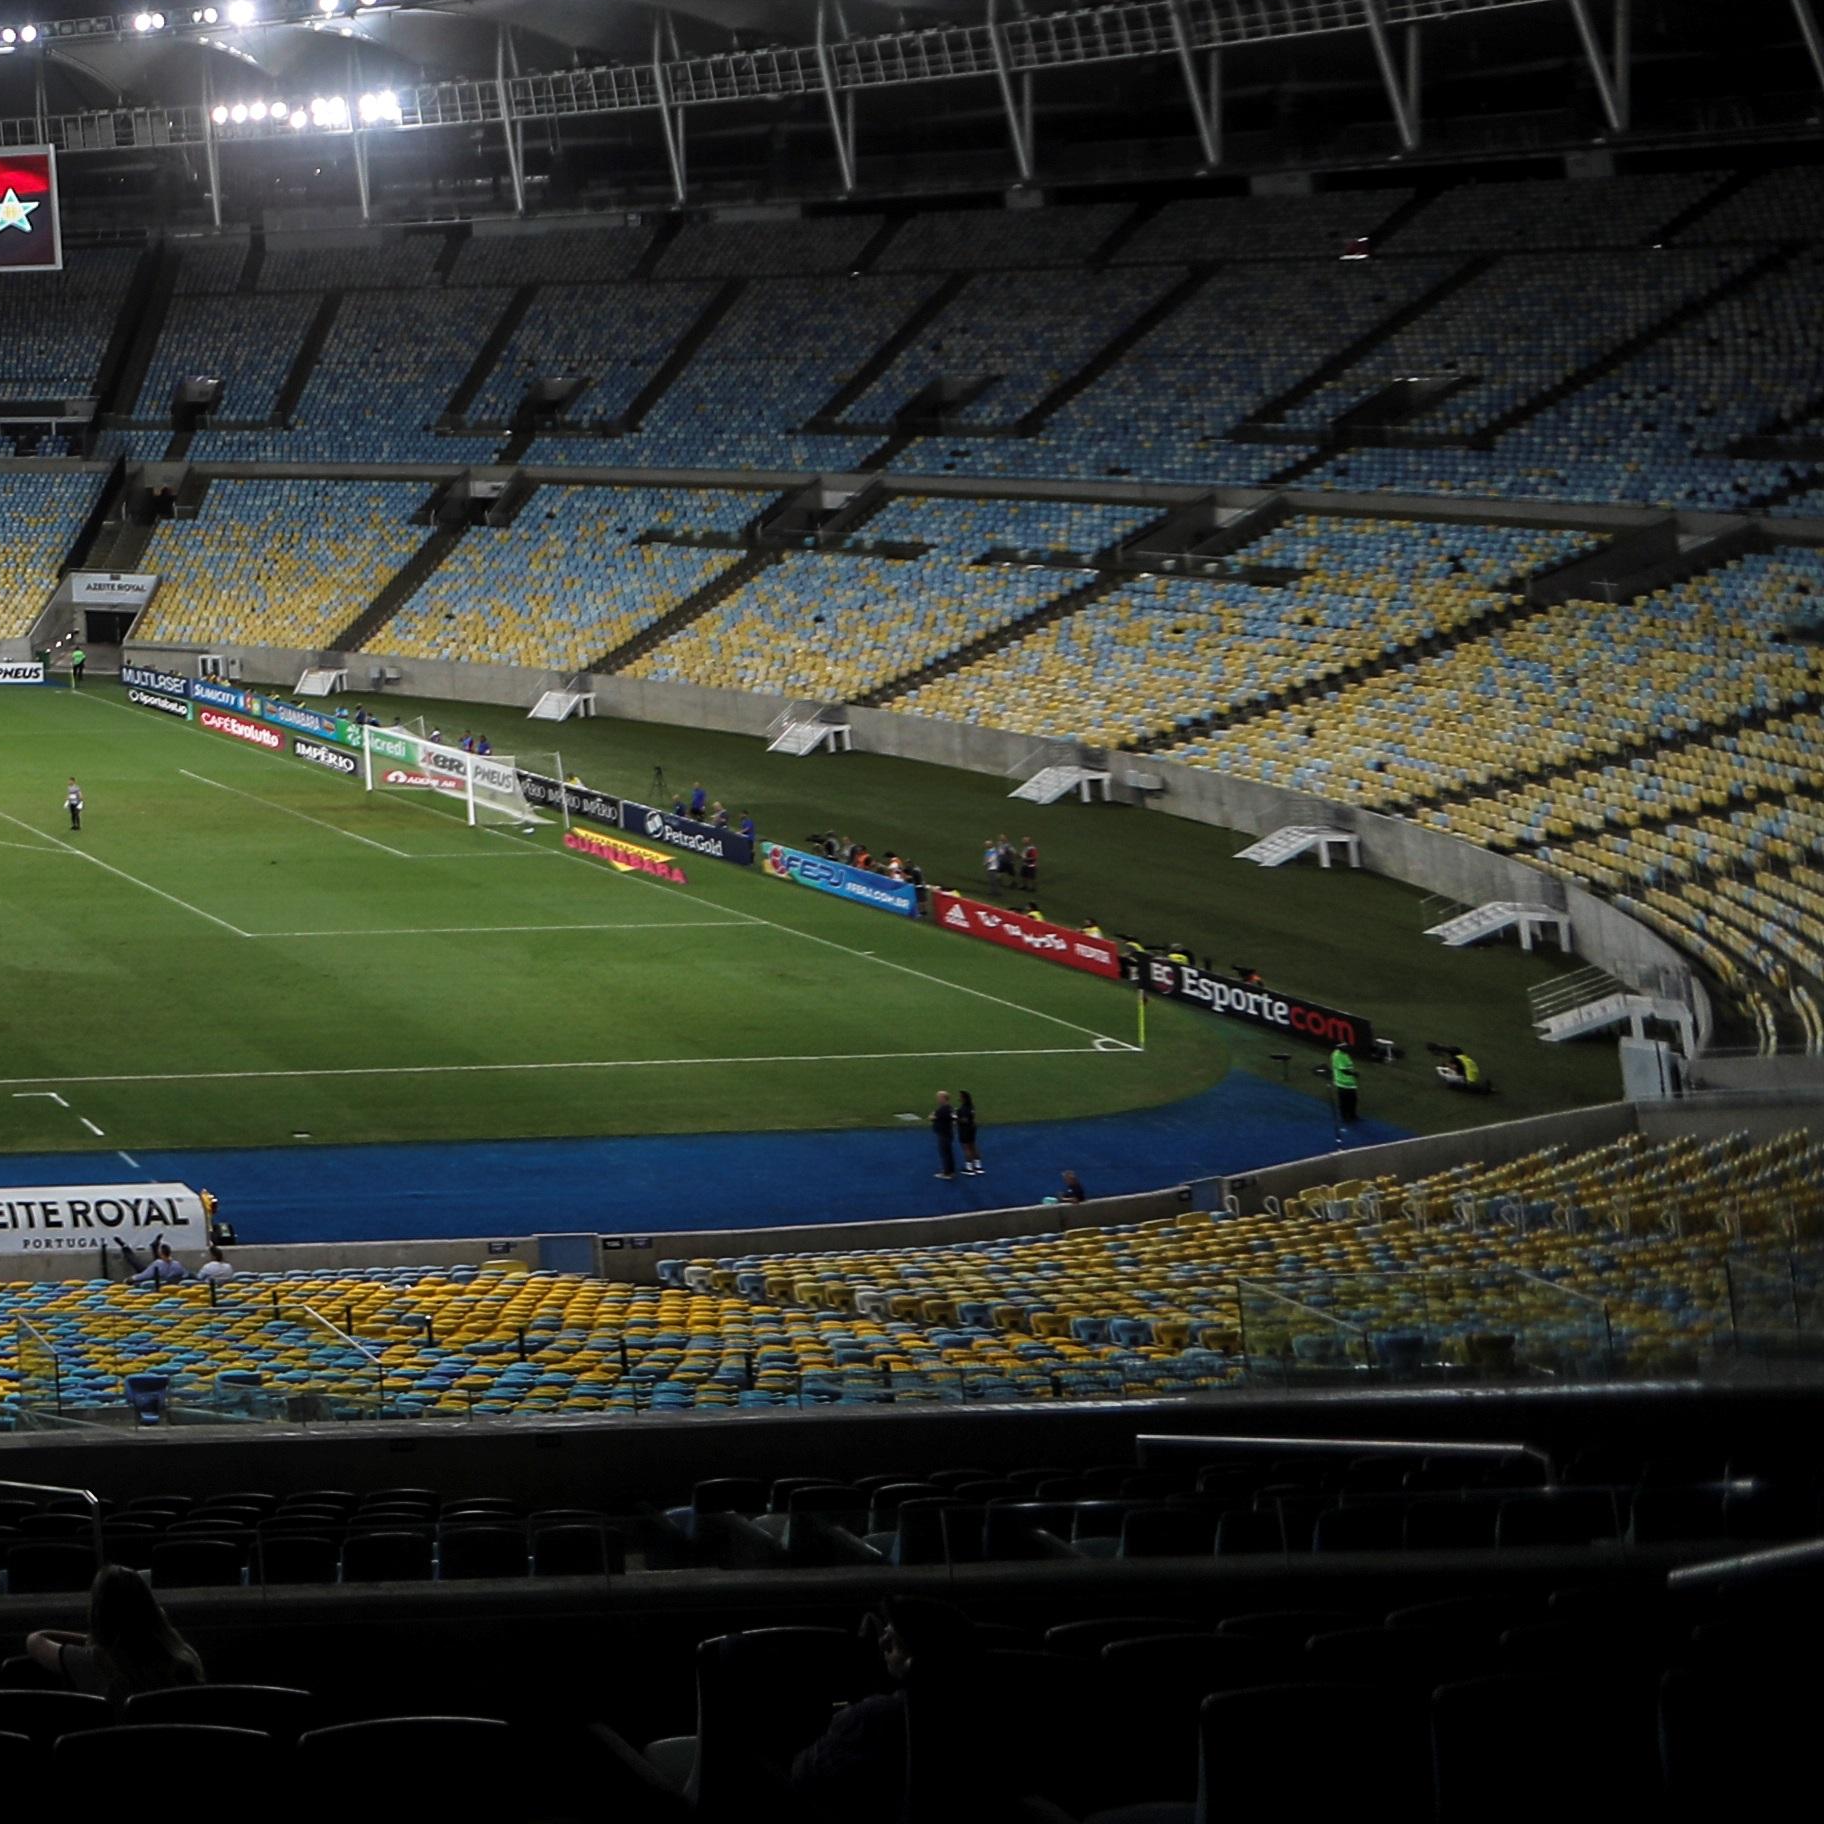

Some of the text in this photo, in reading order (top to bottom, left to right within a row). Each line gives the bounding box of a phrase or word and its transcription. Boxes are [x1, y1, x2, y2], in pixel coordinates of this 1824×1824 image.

[86, 583, 147, 593] AZEITE ROYAL
[365, 735, 407, 757] icredi
[664, 824, 724, 857] PetraGold
[1149, 961, 1175, 986] EC
[68, 1196, 190, 1229] ROYAL
[23, 1237, 109, 1250] PORTUGAL
